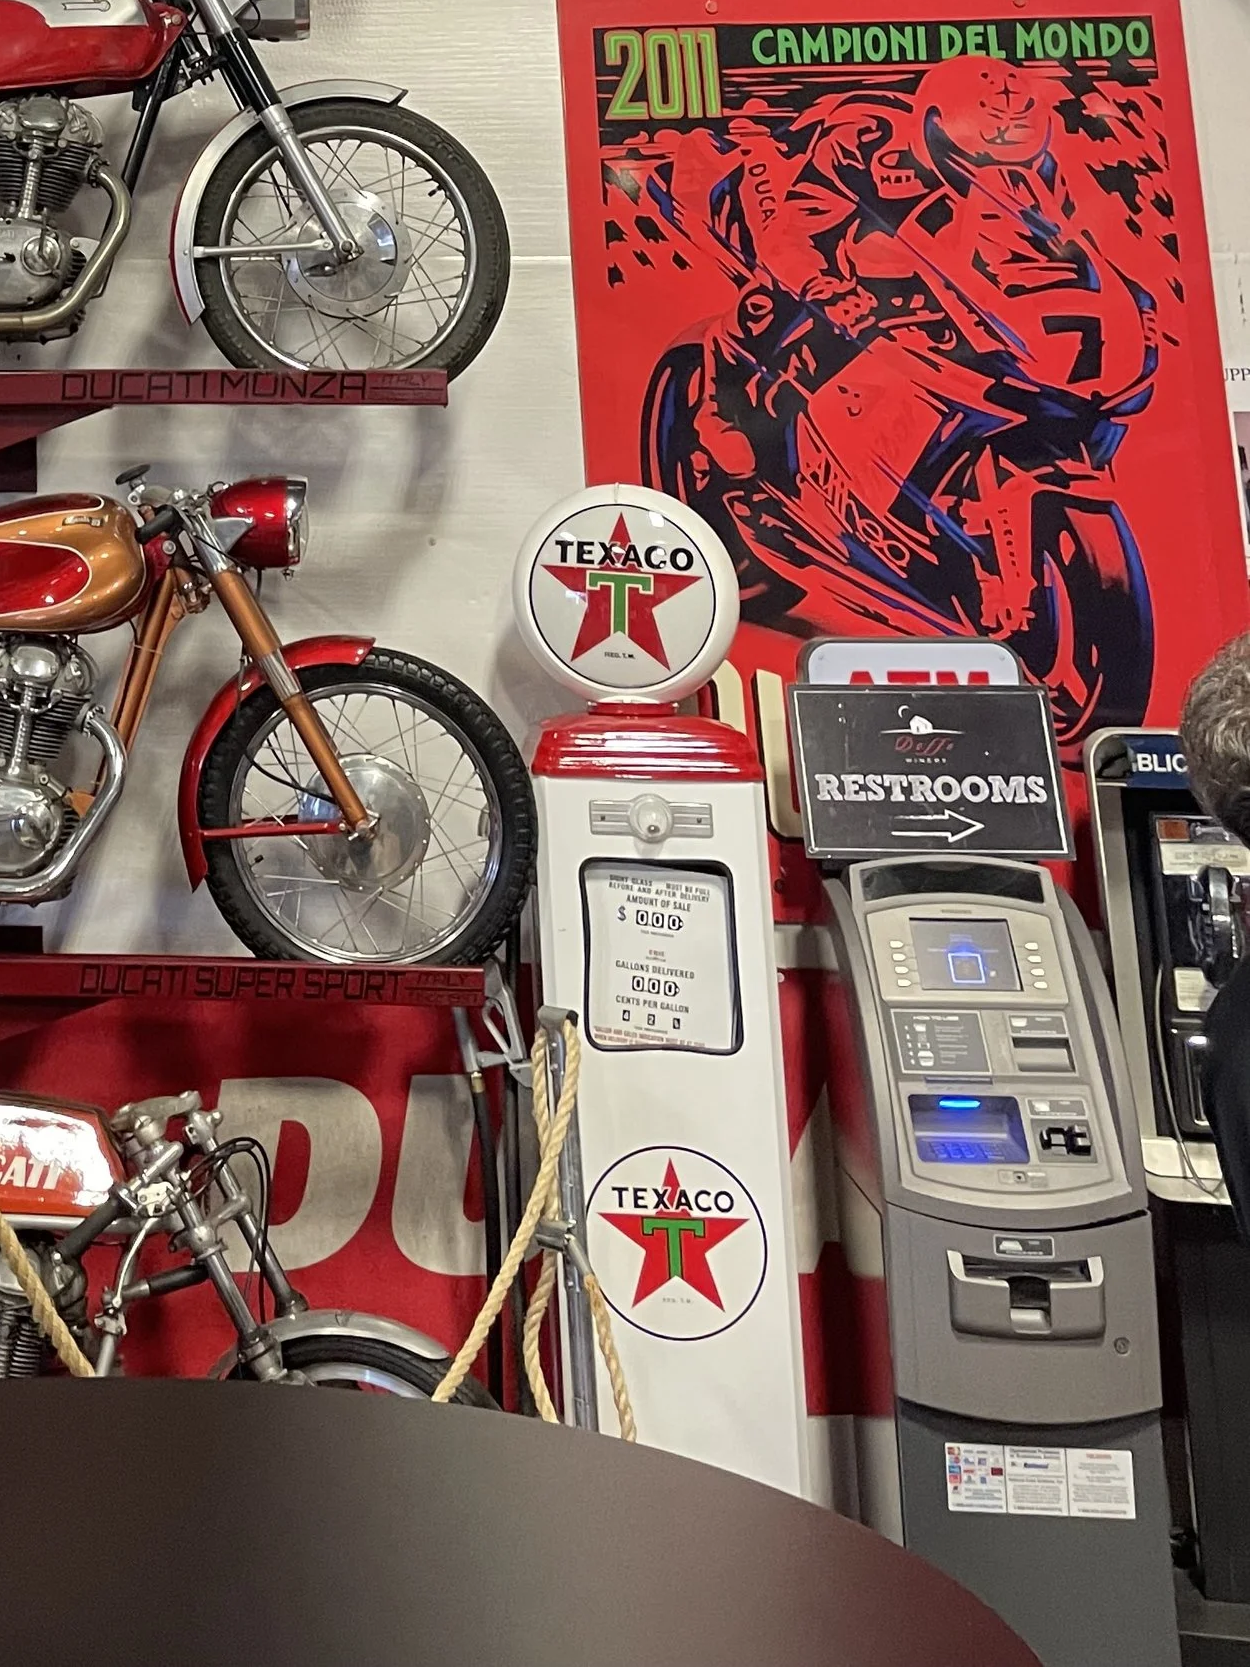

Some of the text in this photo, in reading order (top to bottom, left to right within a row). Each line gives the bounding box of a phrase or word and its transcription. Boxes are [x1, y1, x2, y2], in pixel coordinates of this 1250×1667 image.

[751, 20, 1150, 65] CAMPIONI DEL MONDO
[604, 26, 723, 120] 2011
[61, 372, 208, 402] DUCATI
[218, 372, 367, 401] MONZA
[555, 539, 694, 571] TEXACO
[586, 570, 654, 637] T
[1132, 752, 1188, 773] BLIC
[814, 773, 1048, 804] RESTROOMS
[608, 881, 633, 892] BEFORE
[654, 888, 677, 899] AFTER
[626, 894, 691, 912] AMOUNT OF SALE
[617, 905, 627, 922] $
[79, 963, 187, 994] DUCATI
[193, 966, 295, 999] SUPER
[302, 968, 408, 1001] SPORT
[615, 959, 695, 980] GALLONS DELIVERED
[615, 994, 690, 1014] CENTS PER GALLON
[611, 1186, 735, 1213] TEXACO
[640, 1215, 706, 1280] T
